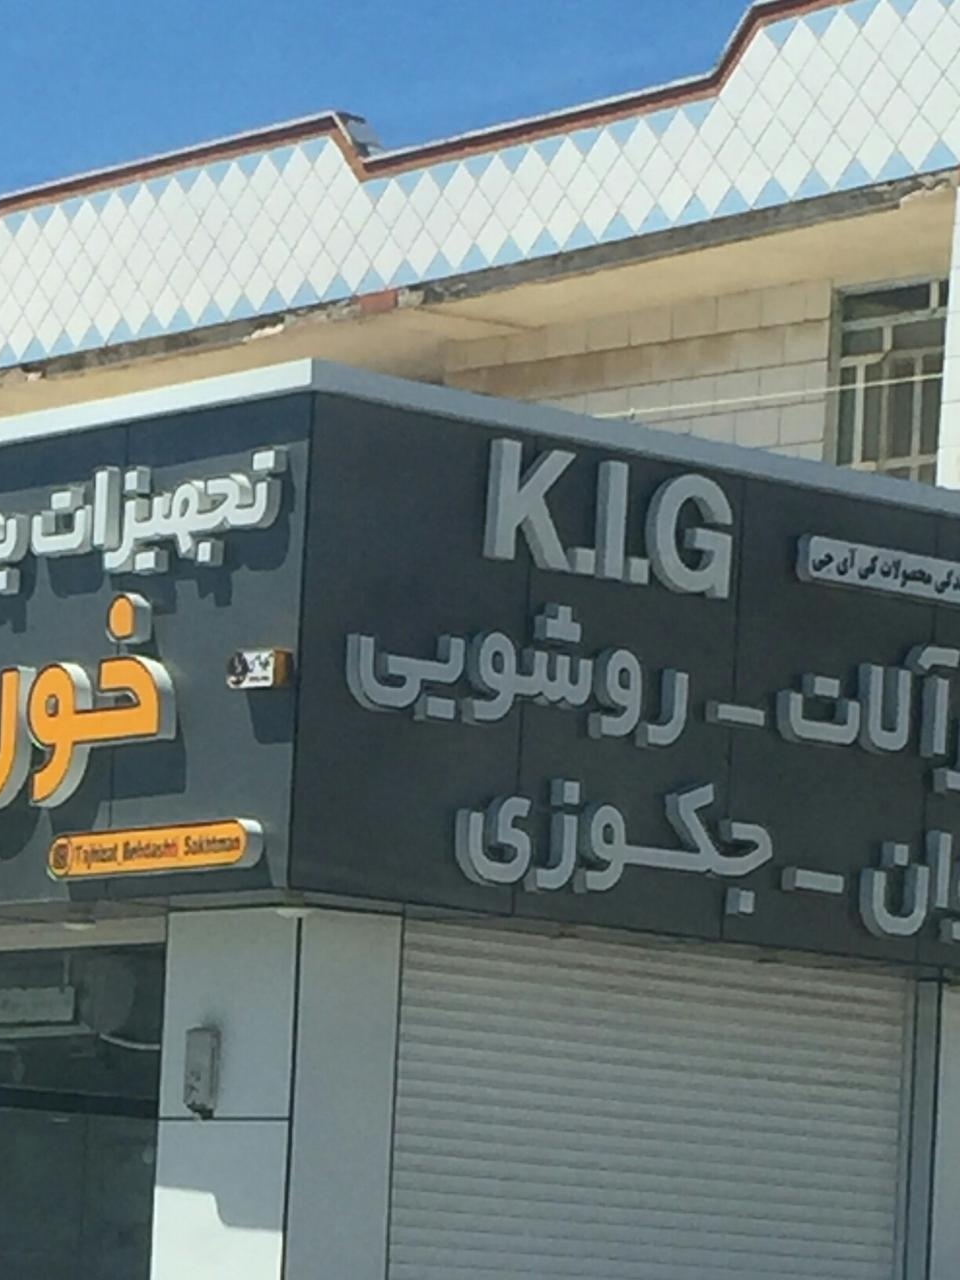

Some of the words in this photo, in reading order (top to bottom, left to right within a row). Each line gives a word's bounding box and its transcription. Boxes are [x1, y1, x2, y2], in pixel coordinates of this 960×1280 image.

[30, 446, 287, 575] تجهیزات
[346, 603, 689, 748] روشویی
[455, 778, 774, 915] جکوزی
[859, 830, 960, 940] ان
